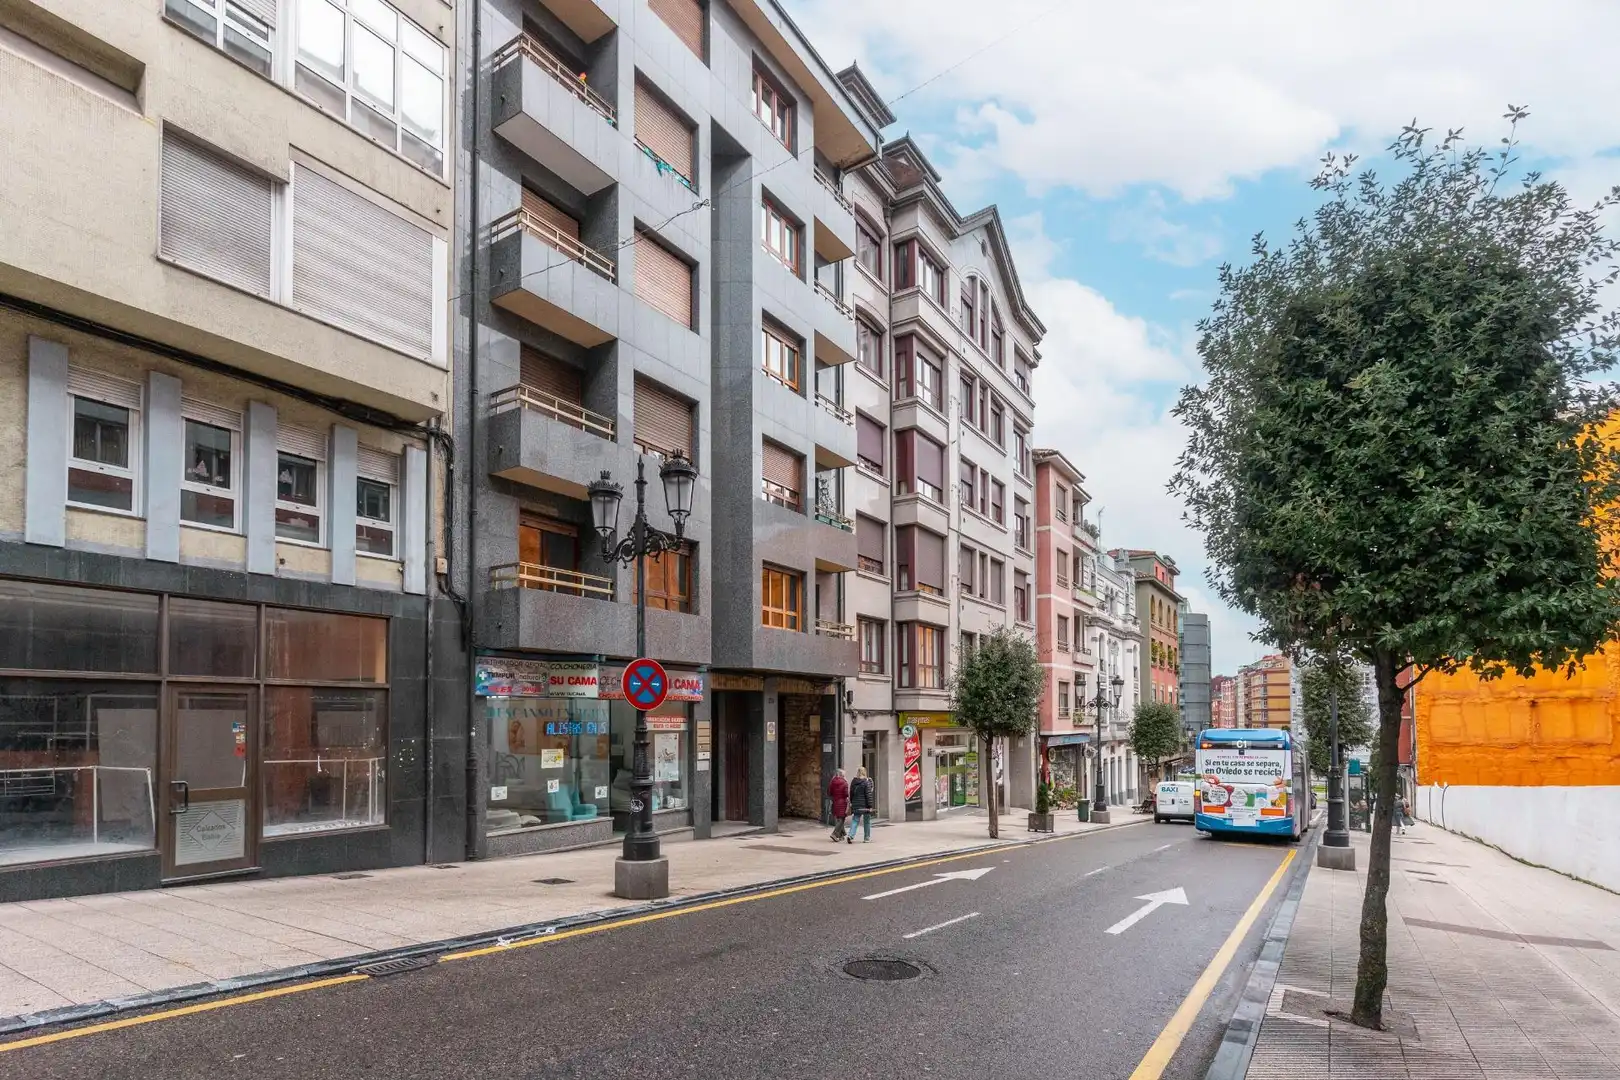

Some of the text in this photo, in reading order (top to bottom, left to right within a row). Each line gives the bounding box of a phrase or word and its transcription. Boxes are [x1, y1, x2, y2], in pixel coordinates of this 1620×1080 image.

[550, 676, 597, 686] SU CAMA
[674, 678, 701, 690] CAMA
[1236, 740, 1247, 749] C1
[1256, 760, 1281, 769] separa,
[1216, 767, 1242, 775] Oviedo
[1254, 767, 1281, 777] recicla
